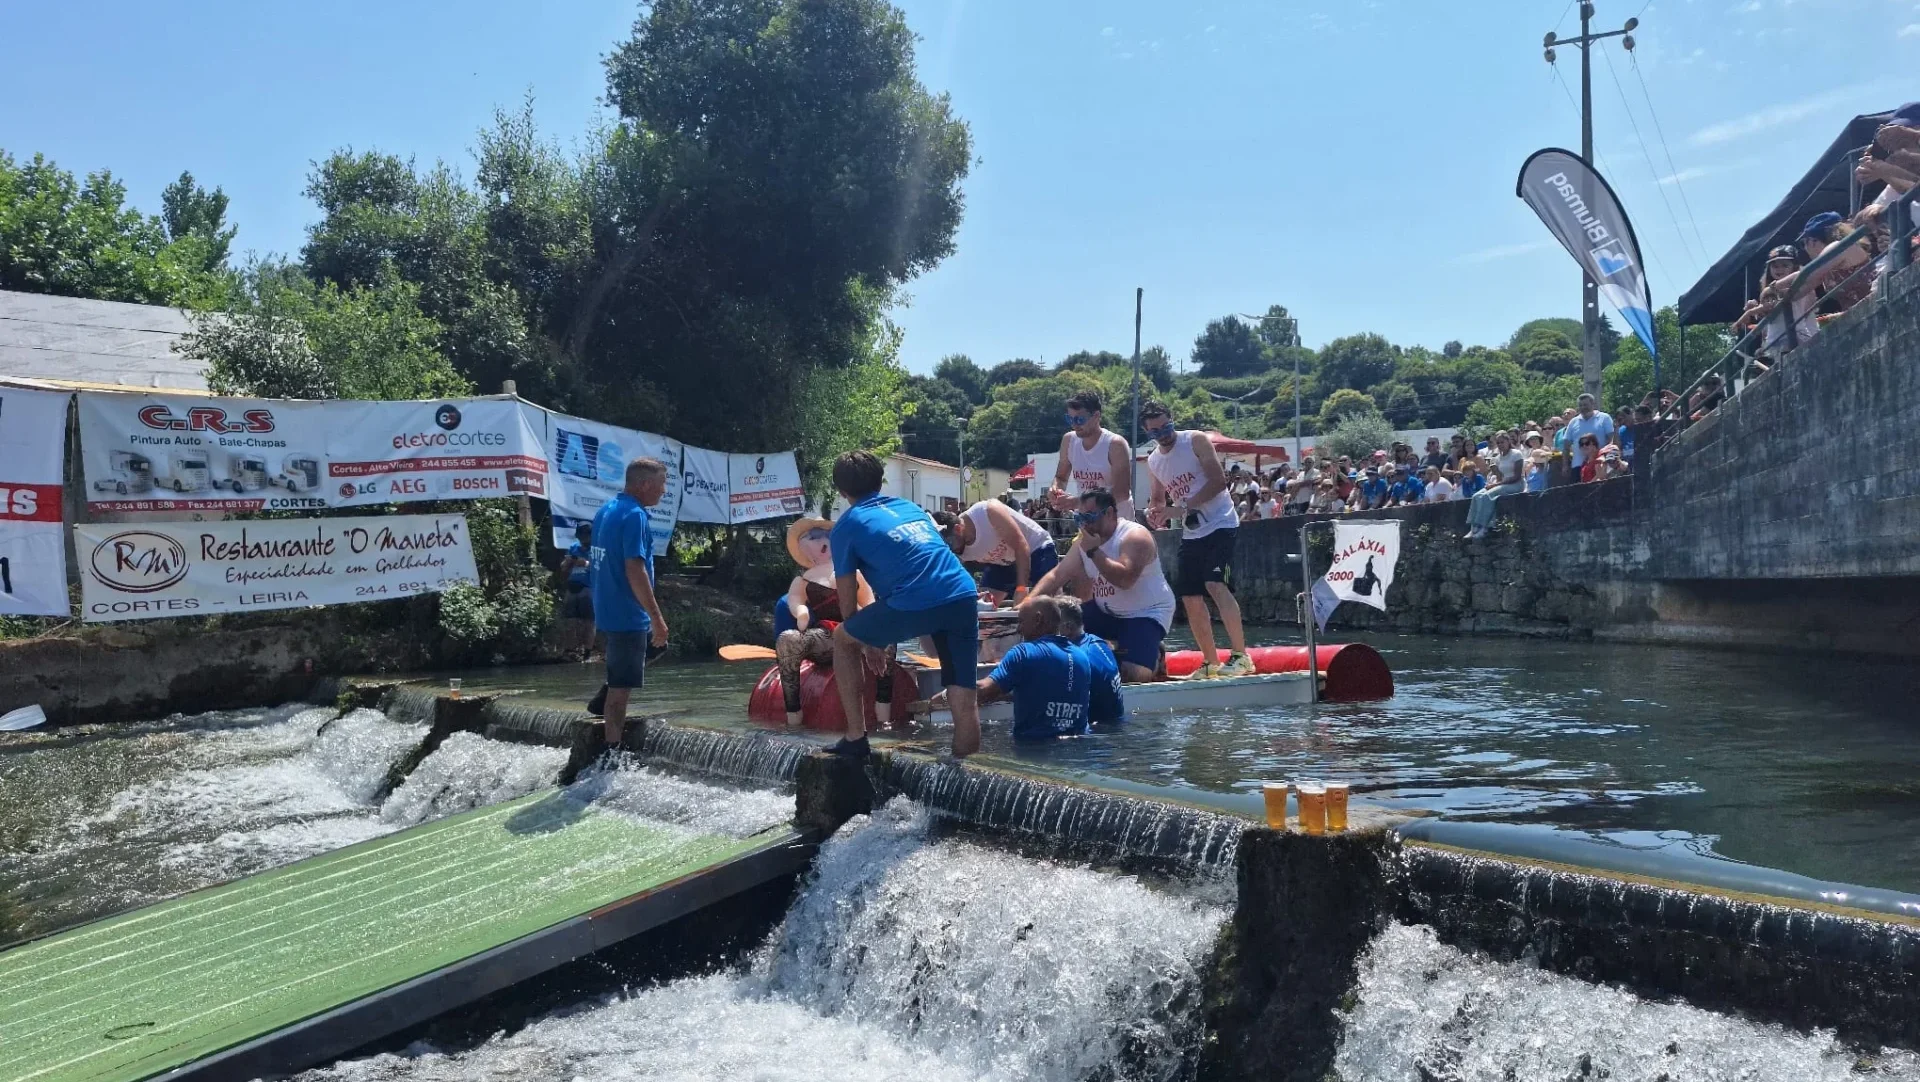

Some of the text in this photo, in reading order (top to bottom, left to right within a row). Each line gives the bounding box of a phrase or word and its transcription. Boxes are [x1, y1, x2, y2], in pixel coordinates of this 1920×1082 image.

[138, 405, 275, 434] C.R.S
[130, 435, 171, 445] Pintura
[174, 437, 201, 446] Auto
[219, 437, 286, 448] Bate-Chapas
[393, 430, 506, 449] eletrocortes
[333, 465, 363, 473] Cortes
[369, 464, 388, 473] Alto
[421, 460, 440, 468] 244
[460, 458, 477, 466] 455
[358, 482, 377, 494] LG
[390, 479, 426, 494] AEG
[453, 478, 499, 489] BOSCH
[116, 502, 134, 510] 244
[245, 500, 260, 508] 377
[270, 498, 325, 509] CORTES
[200, 525, 336, 561] Restaurante
[1333, 536, 1386, 564] GALÁXIA
[226, 556, 447, 585] Especialidade em Grelhados
[1327, 571, 1354, 581] 3000
[91, 598, 200, 615] CORTES
[239, 590, 308, 605] LEIRIA
[356, 585, 388, 596] 244
